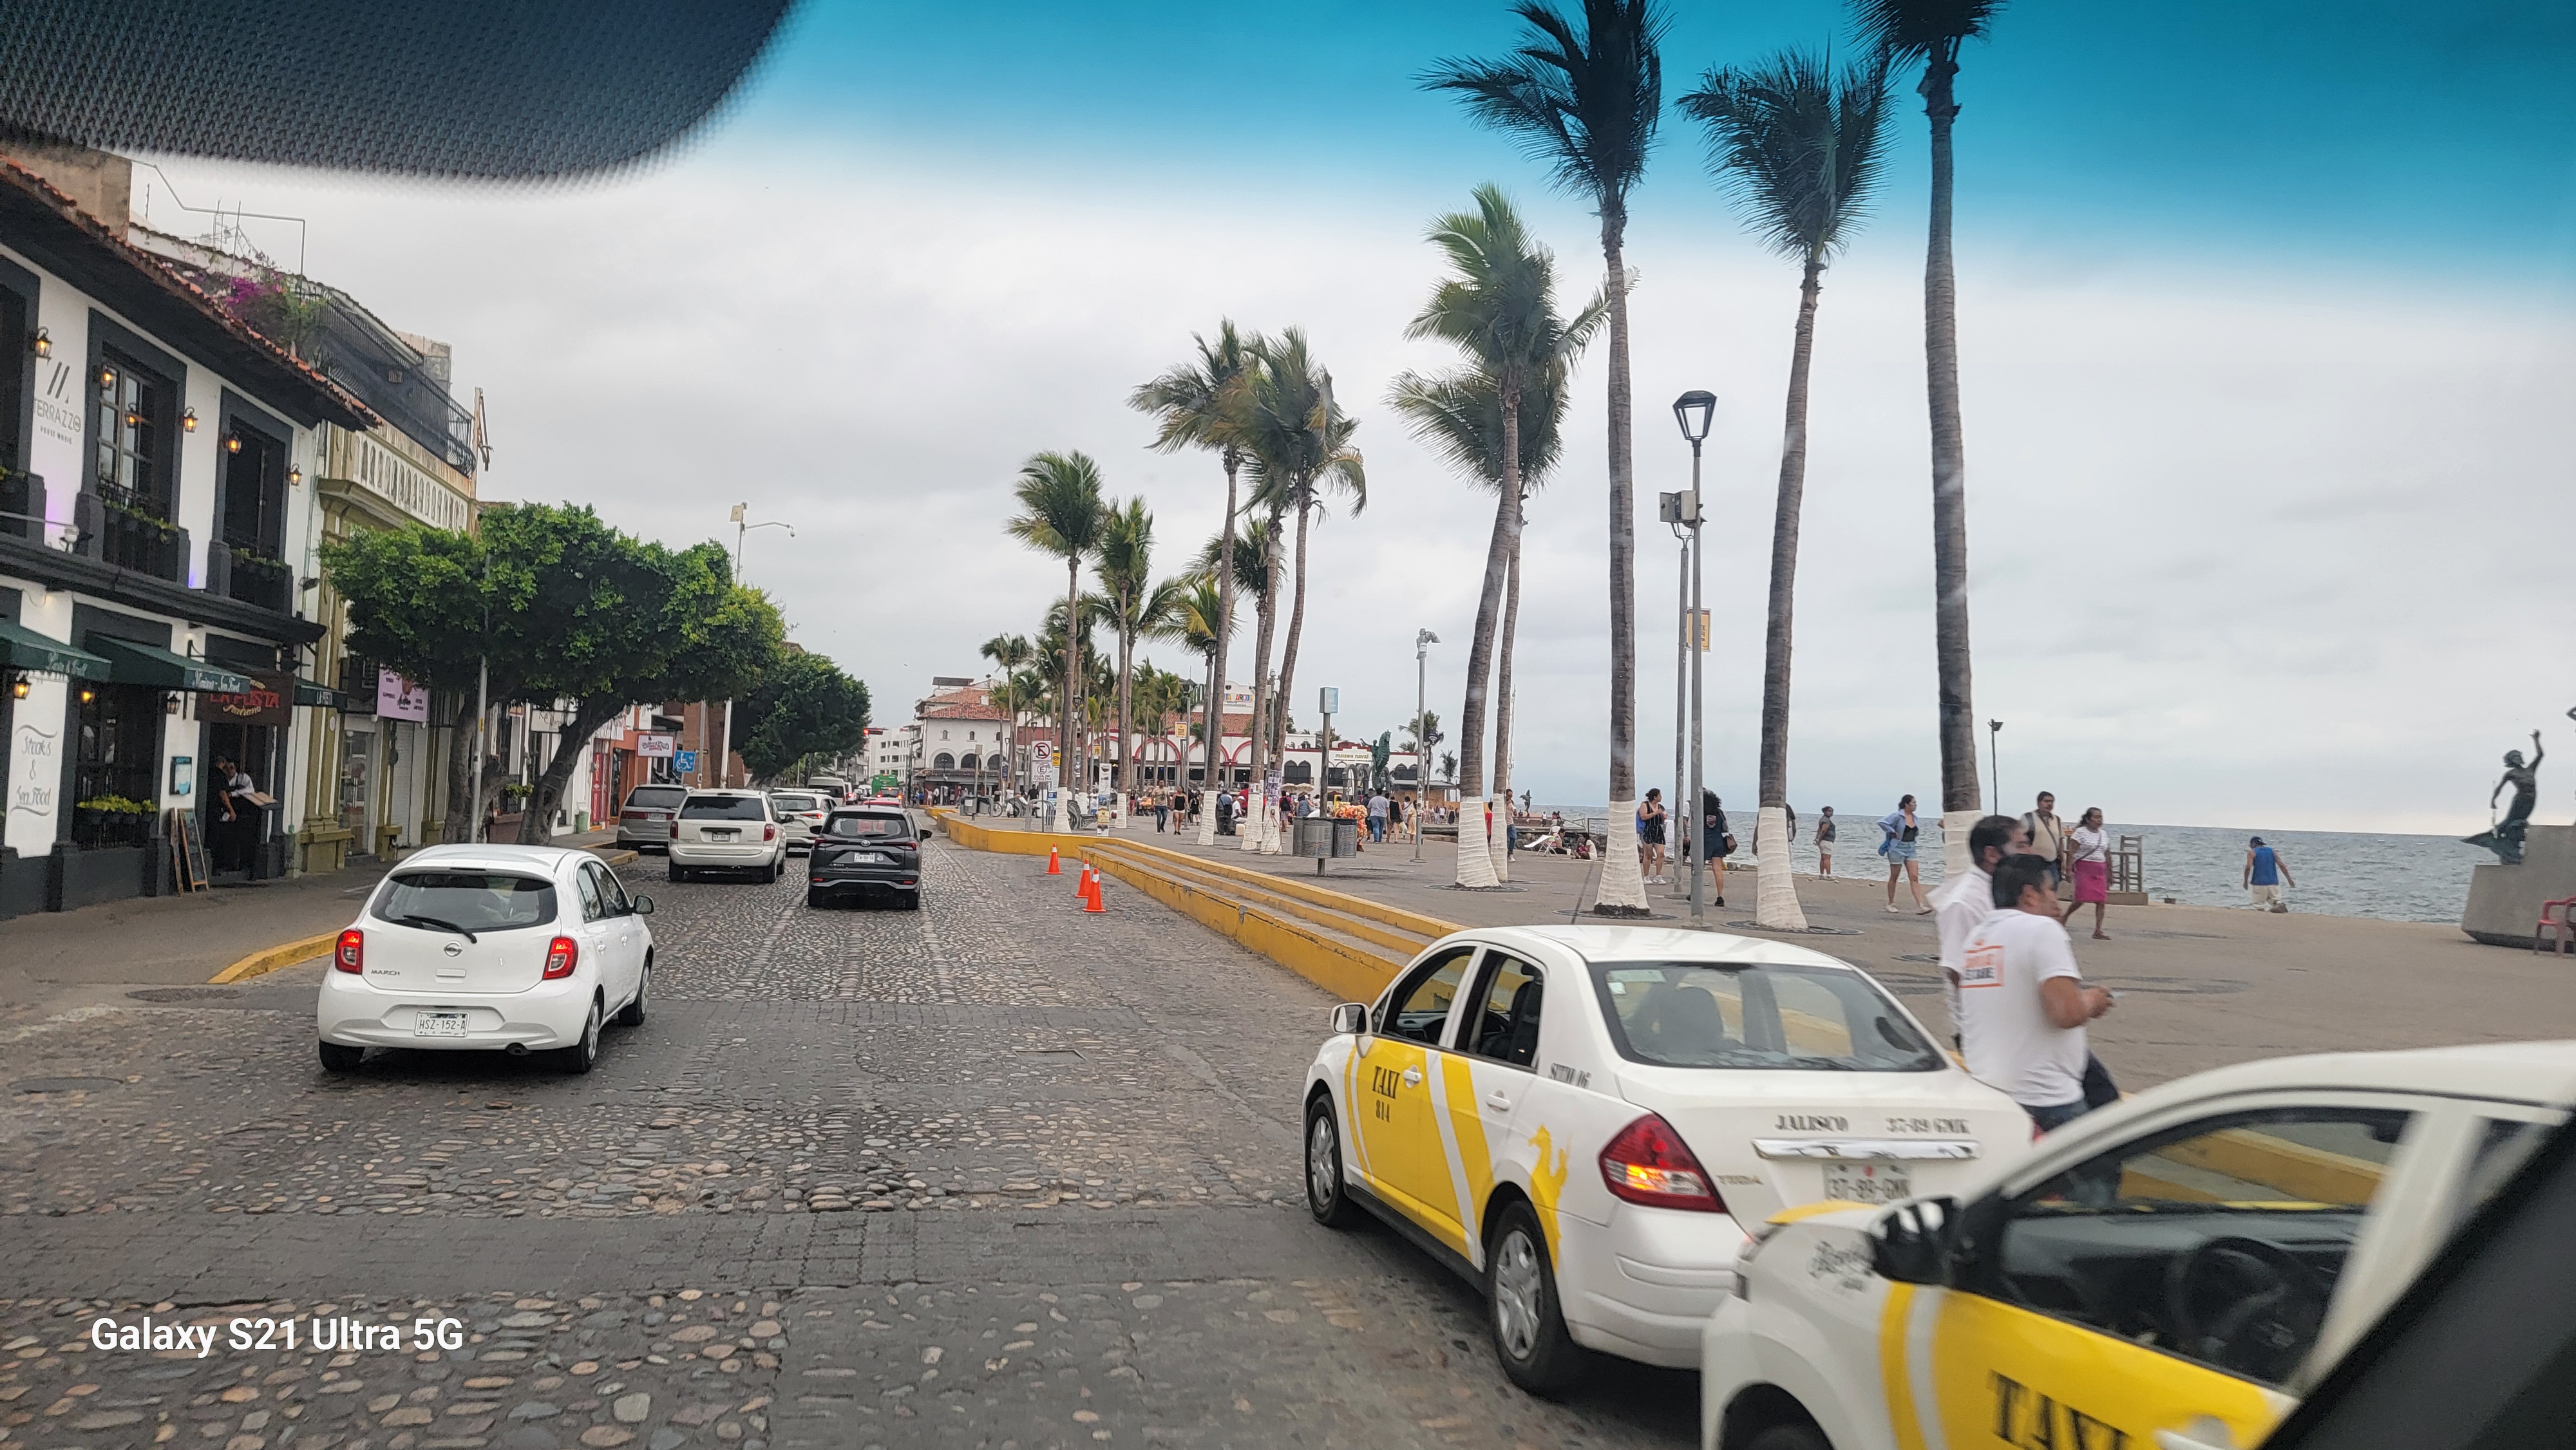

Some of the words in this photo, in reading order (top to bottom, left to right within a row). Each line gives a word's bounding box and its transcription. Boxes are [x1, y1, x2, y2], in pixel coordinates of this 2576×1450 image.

[419, 1019, 466, 1030] HSZ-152-A
[1372, 1065, 1401, 1100] TAXI
[1775, 1115, 1850, 1133] JALISCO
